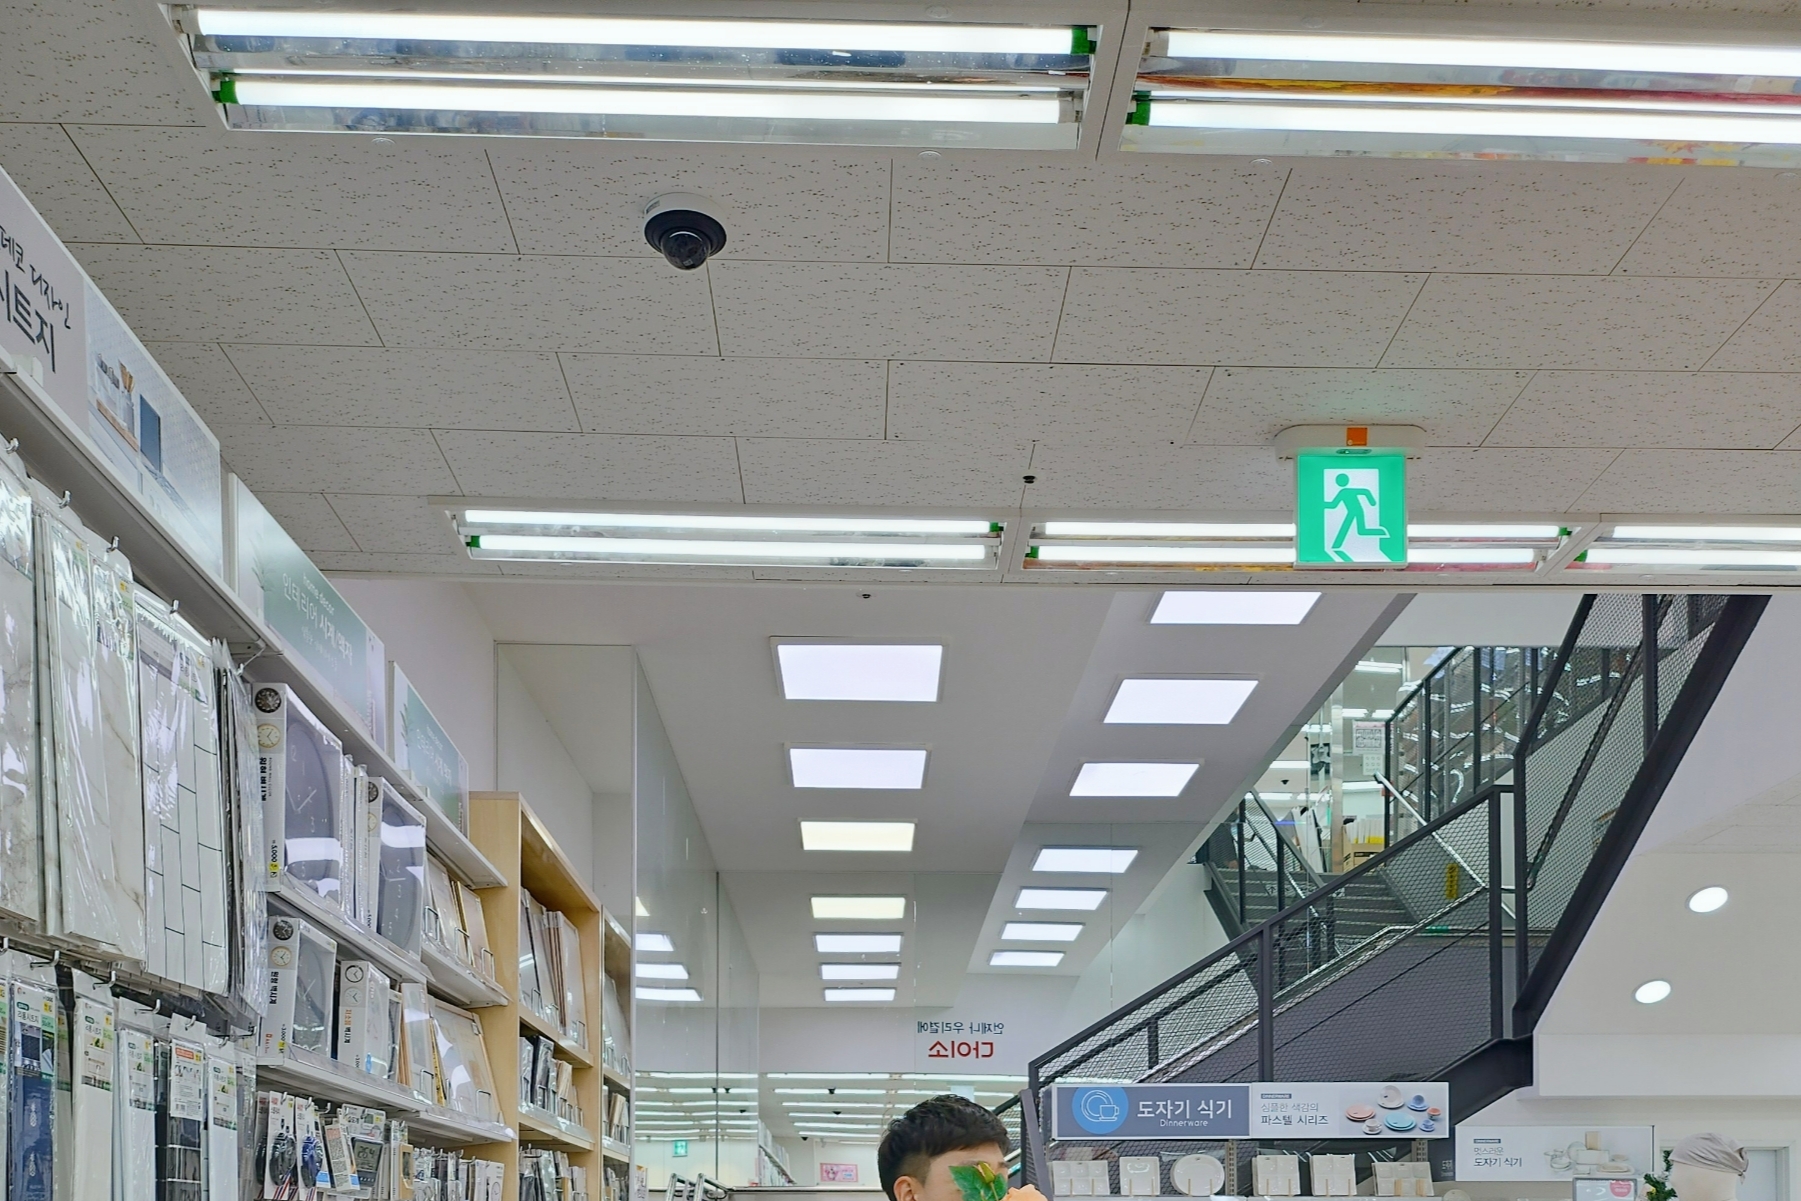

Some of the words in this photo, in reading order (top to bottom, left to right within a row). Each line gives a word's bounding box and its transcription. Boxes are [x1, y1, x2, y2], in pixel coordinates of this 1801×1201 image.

[282, 573, 318, 629] 인테리어
[1137, 1099, 1191, 1119] 도자기
[1197, 1098, 1232, 1119] 식기
[1261, 1102, 1289, 1113] 심플한
[1291, 1102, 1319, 1113] 색감의
[1160, 1118, 1208, 1127] Dinnerware
[1261, 1114, 1293, 1126] 파스텔
[1297, 1114, 1329, 1125] 시리즈
[1474, 1157, 1501, 1168] 도자기
[1504, 1157, 1523, 1167] 식기
